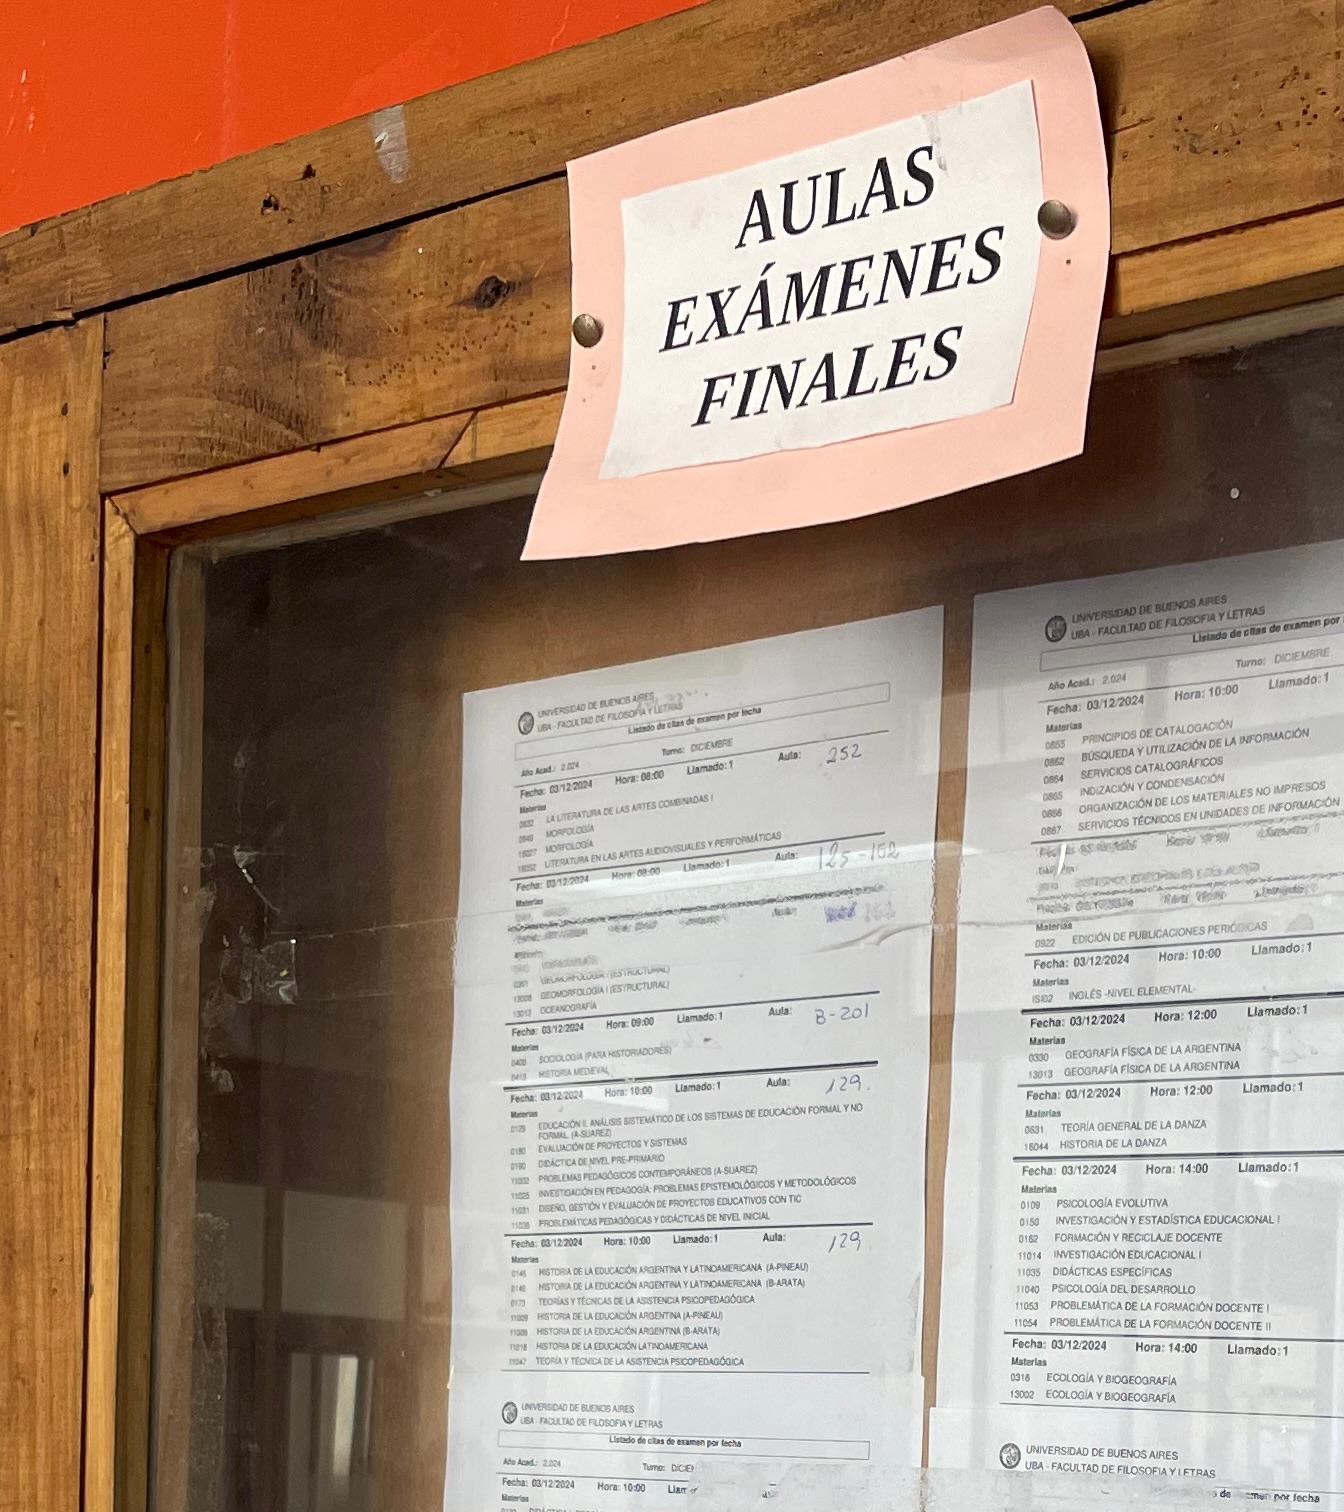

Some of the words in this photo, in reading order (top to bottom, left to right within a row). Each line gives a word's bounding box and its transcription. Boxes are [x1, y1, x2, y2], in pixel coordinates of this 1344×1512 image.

[735, 145, 934, 249] AULAS
[658, 226, 1004, 352] EXÁMENES
[690, 326, 963, 428] FINALES
[1047, 703, 1082, 716] Fecha:
[1087, 694, 1145, 711] 03/12/2024
[1175, 690, 1206, 702] Hora:
[1208, 683, 1239, 697] 10:00
[827, 743, 864, 765] 252
[606, 1019, 630, 1030] Hora:
[630, 1016, 655, 1028] 09:00
[768, 1006, 793, 1017] Aula:
[1030, 1017, 1066, 1029] Fecha:
[1069, 1013, 1126, 1027] 03/12/2024
[1155, 1011, 1185, 1023] Hora:
[1187, 1008, 1218, 1021] 12:00
[1022, 1165, 1057, 1177] Fecha:
[1062, 1163, 1117, 1176] 03/12/2024
[1146, 1163, 1176, 1175] Hora:
[1178, 1162, 1209, 1175] 14:00
[763, 1232, 787, 1243] Aula:
[1026, 1444, 1090, 1457] UNIVERSIDAD
[1091, 1447, 1106, 1458] DE
[1106, 1447, 1148, 1460] BUENOS
[1148, 1450, 1179, 1461] AIRES
